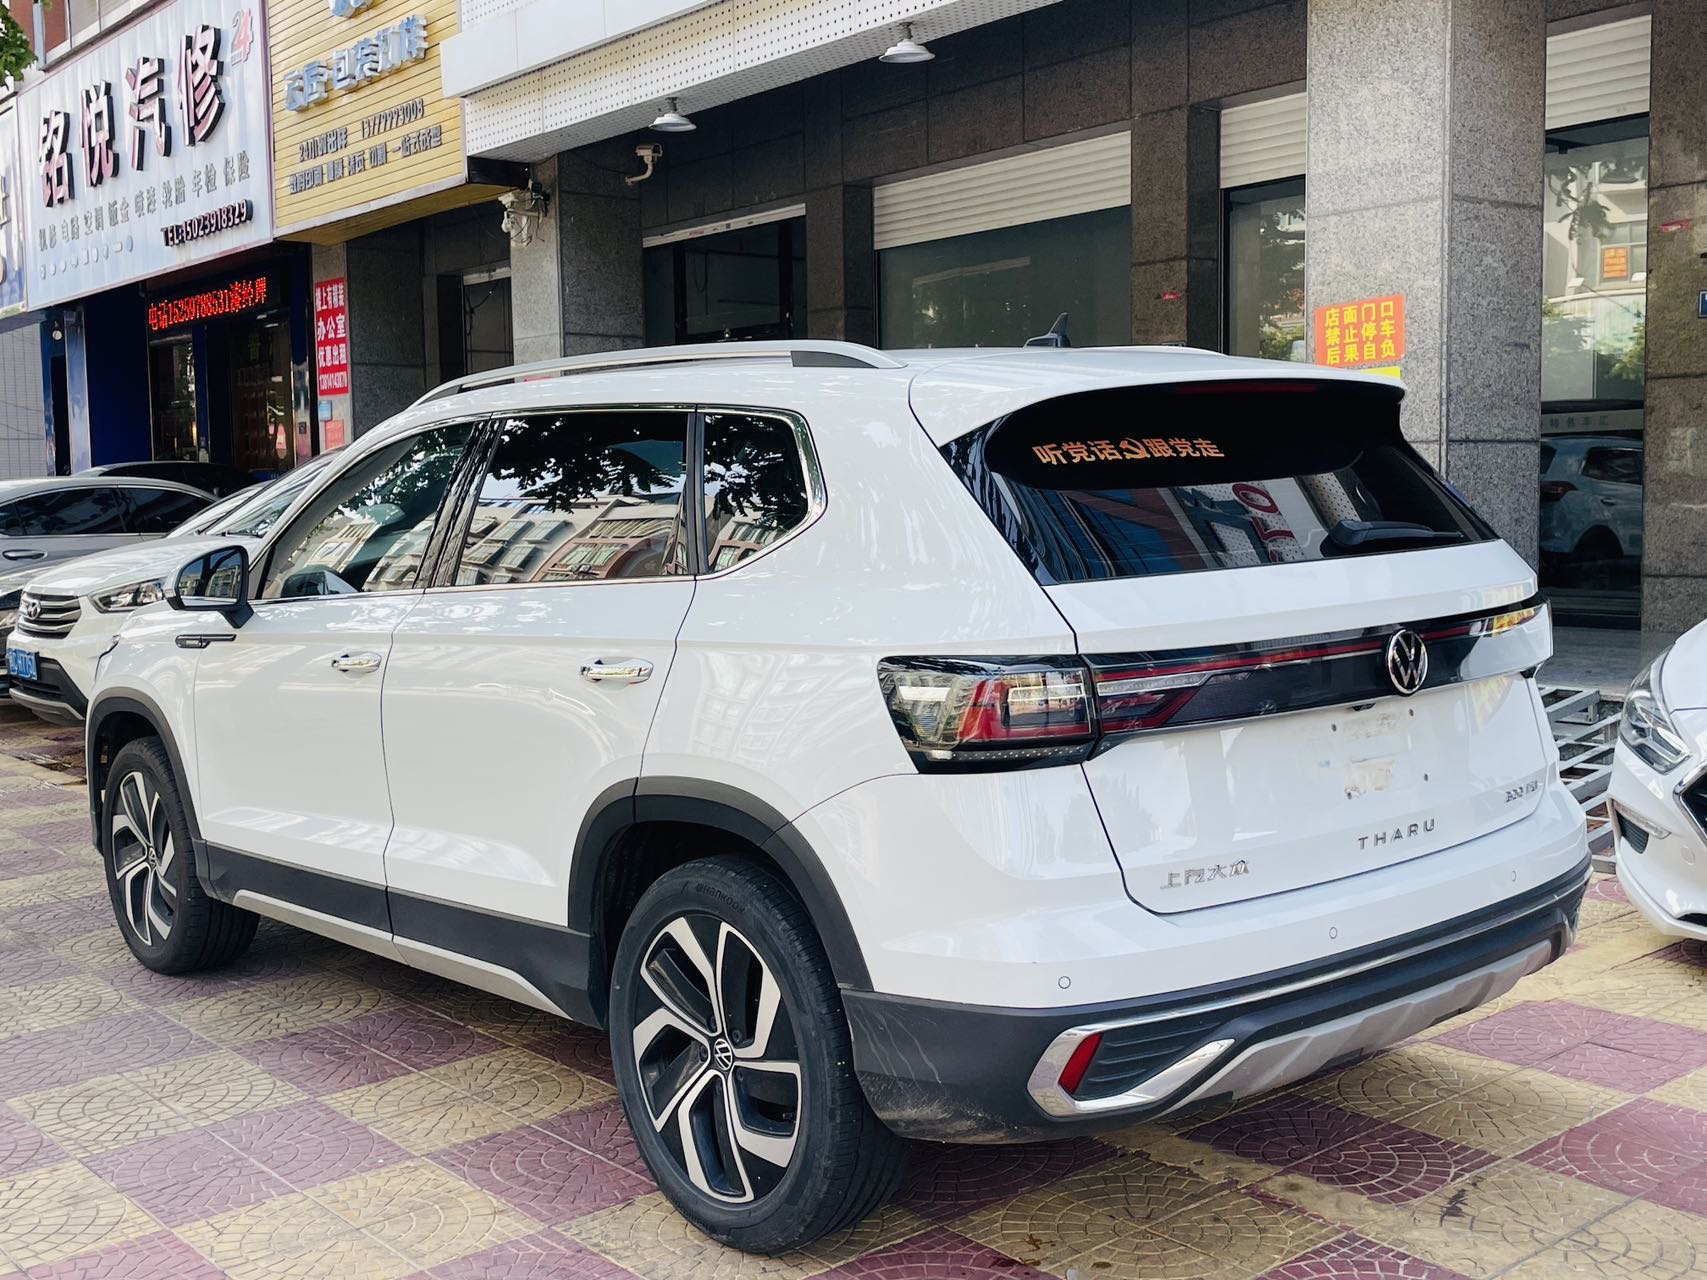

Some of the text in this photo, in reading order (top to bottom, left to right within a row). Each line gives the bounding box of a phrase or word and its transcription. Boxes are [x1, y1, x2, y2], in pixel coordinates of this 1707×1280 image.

[191, 162, 217, 198] 年检
[223, 150, 250, 186] 保险
[317, 313, 346, 341] 办公室
[1325, 301, 1395, 327] 店面门口
[1325, 319, 1396, 346] 禁止停车
[318, 344, 347, 367] 优惠出租
[1326, 339, 1396, 365] 后果自负
[1032, 437, 1225, 466] 听党话 跟党走
[1357, 818, 1436, 850] THARU
[1160, 859, 1251, 890] 上汽大众
